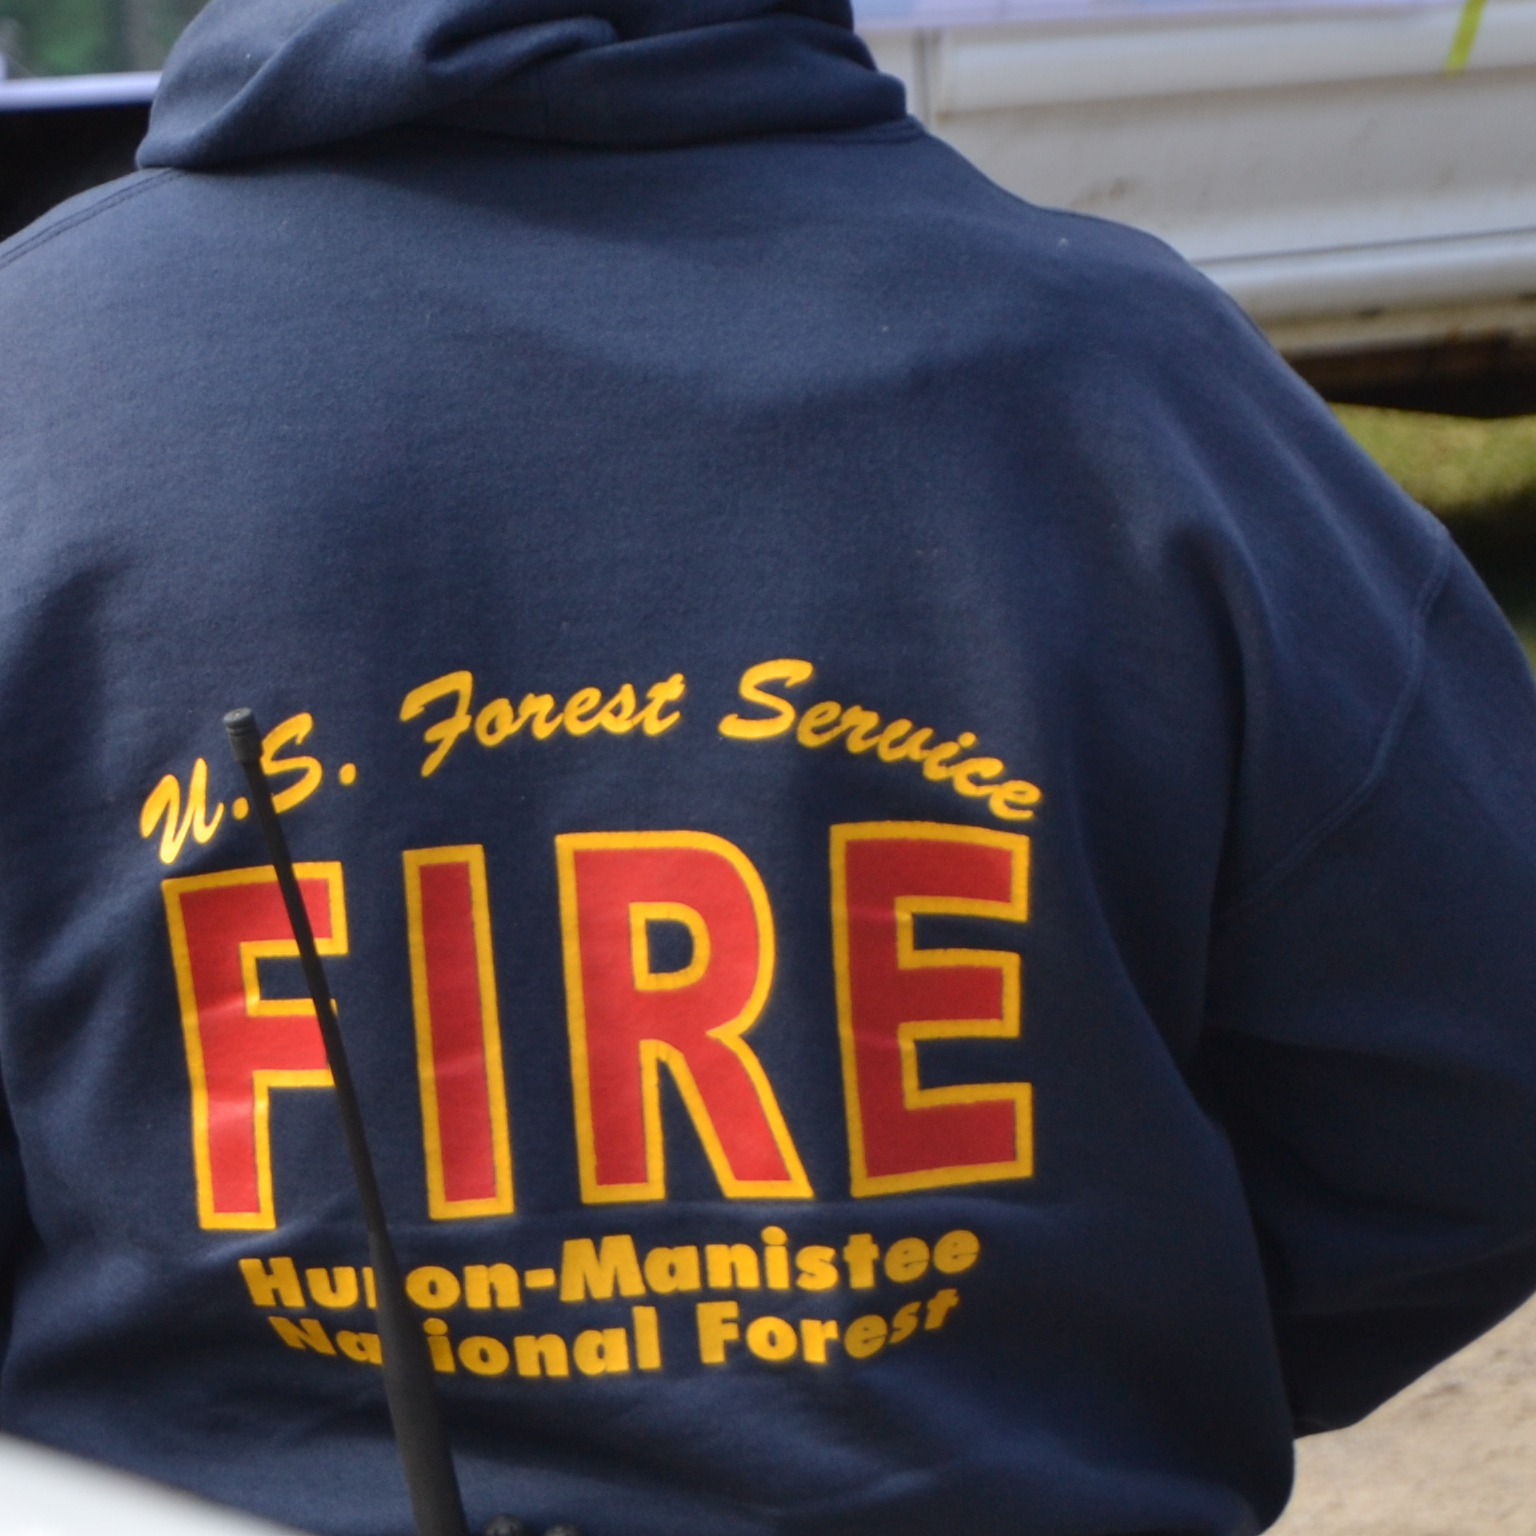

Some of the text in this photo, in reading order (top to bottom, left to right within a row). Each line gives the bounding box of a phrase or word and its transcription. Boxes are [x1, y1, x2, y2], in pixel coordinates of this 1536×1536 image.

[140, 658, 1041, 863] U.S. Forest Service
[162, 820, 1033, 1229] FIRE
[268, 1288, 959, 1378] Naional Forest
